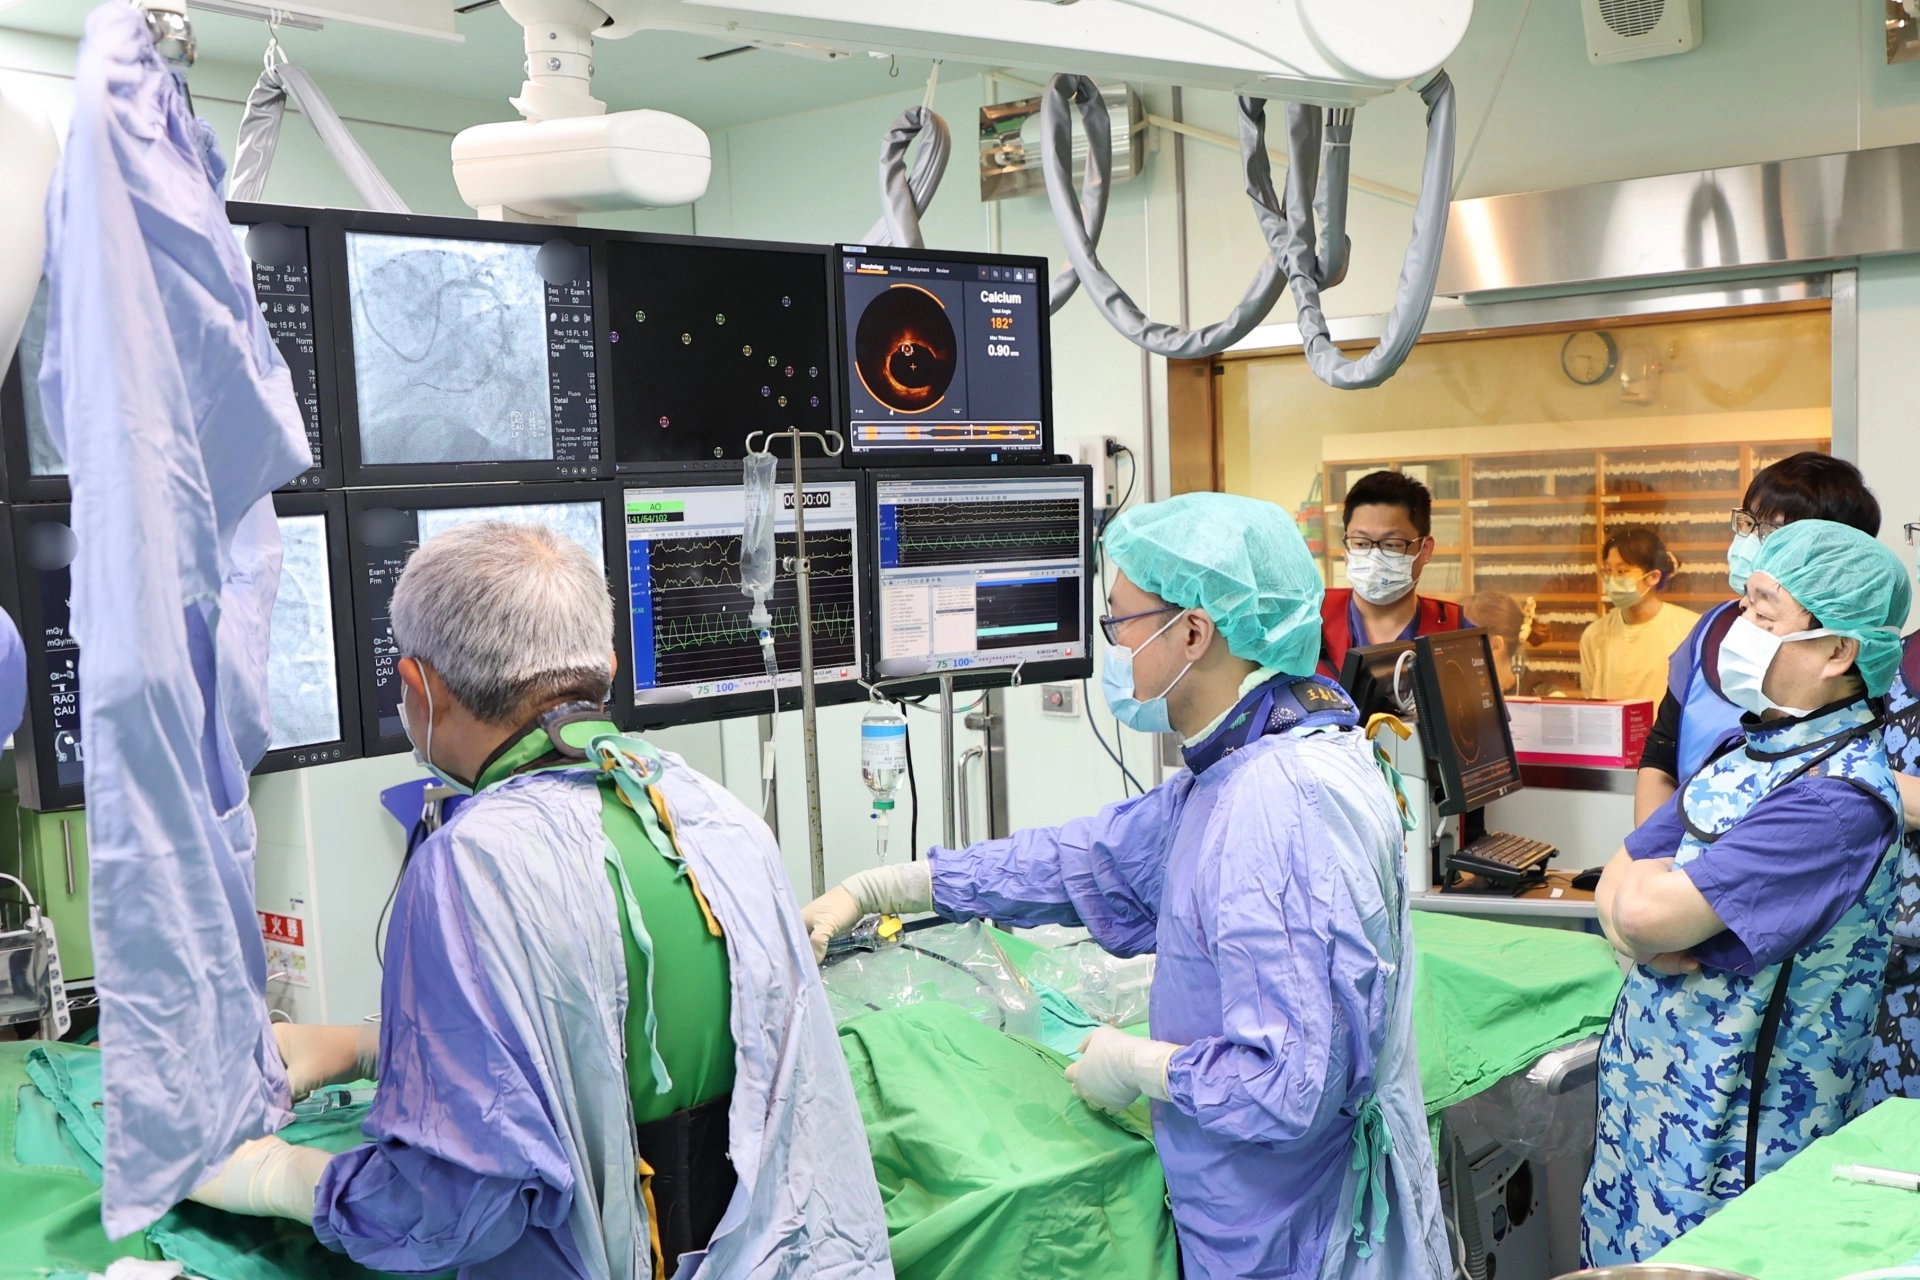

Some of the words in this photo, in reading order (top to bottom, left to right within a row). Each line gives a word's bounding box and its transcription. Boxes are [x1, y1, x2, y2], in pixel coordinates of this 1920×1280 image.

[256, 264, 275, 272] Photo
[286, 265, 291, 273] 3
[860, 263, 884, 271] Morphology
[256, 274, 270, 282] Seq
[548, 287, 559, 295] Seq
[980, 290, 1022, 304] Calcium
[991, 317, 1013, 329] 182°
[987, 344, 1010, 357] 0.90
[784, 493, 829, 506] 0000:00
[650, 503, 662, 511] AO
[628, 514, 668, 523] 141/64/102
[368, 568, 385, 576] Exam
[46, 627, 64, 636] mGy
[376, 657, 392, 666] LAO
[936, 660, 948, 669] 75
[376, 666, 394, 676] CAU
[377, 678, 387, 686] LP
[697, 685, 710, 695] 75
[53, 694, 75, 705] RAO
[54, 705, 76, 716] CAU
[55, 719, 62, 728] L
